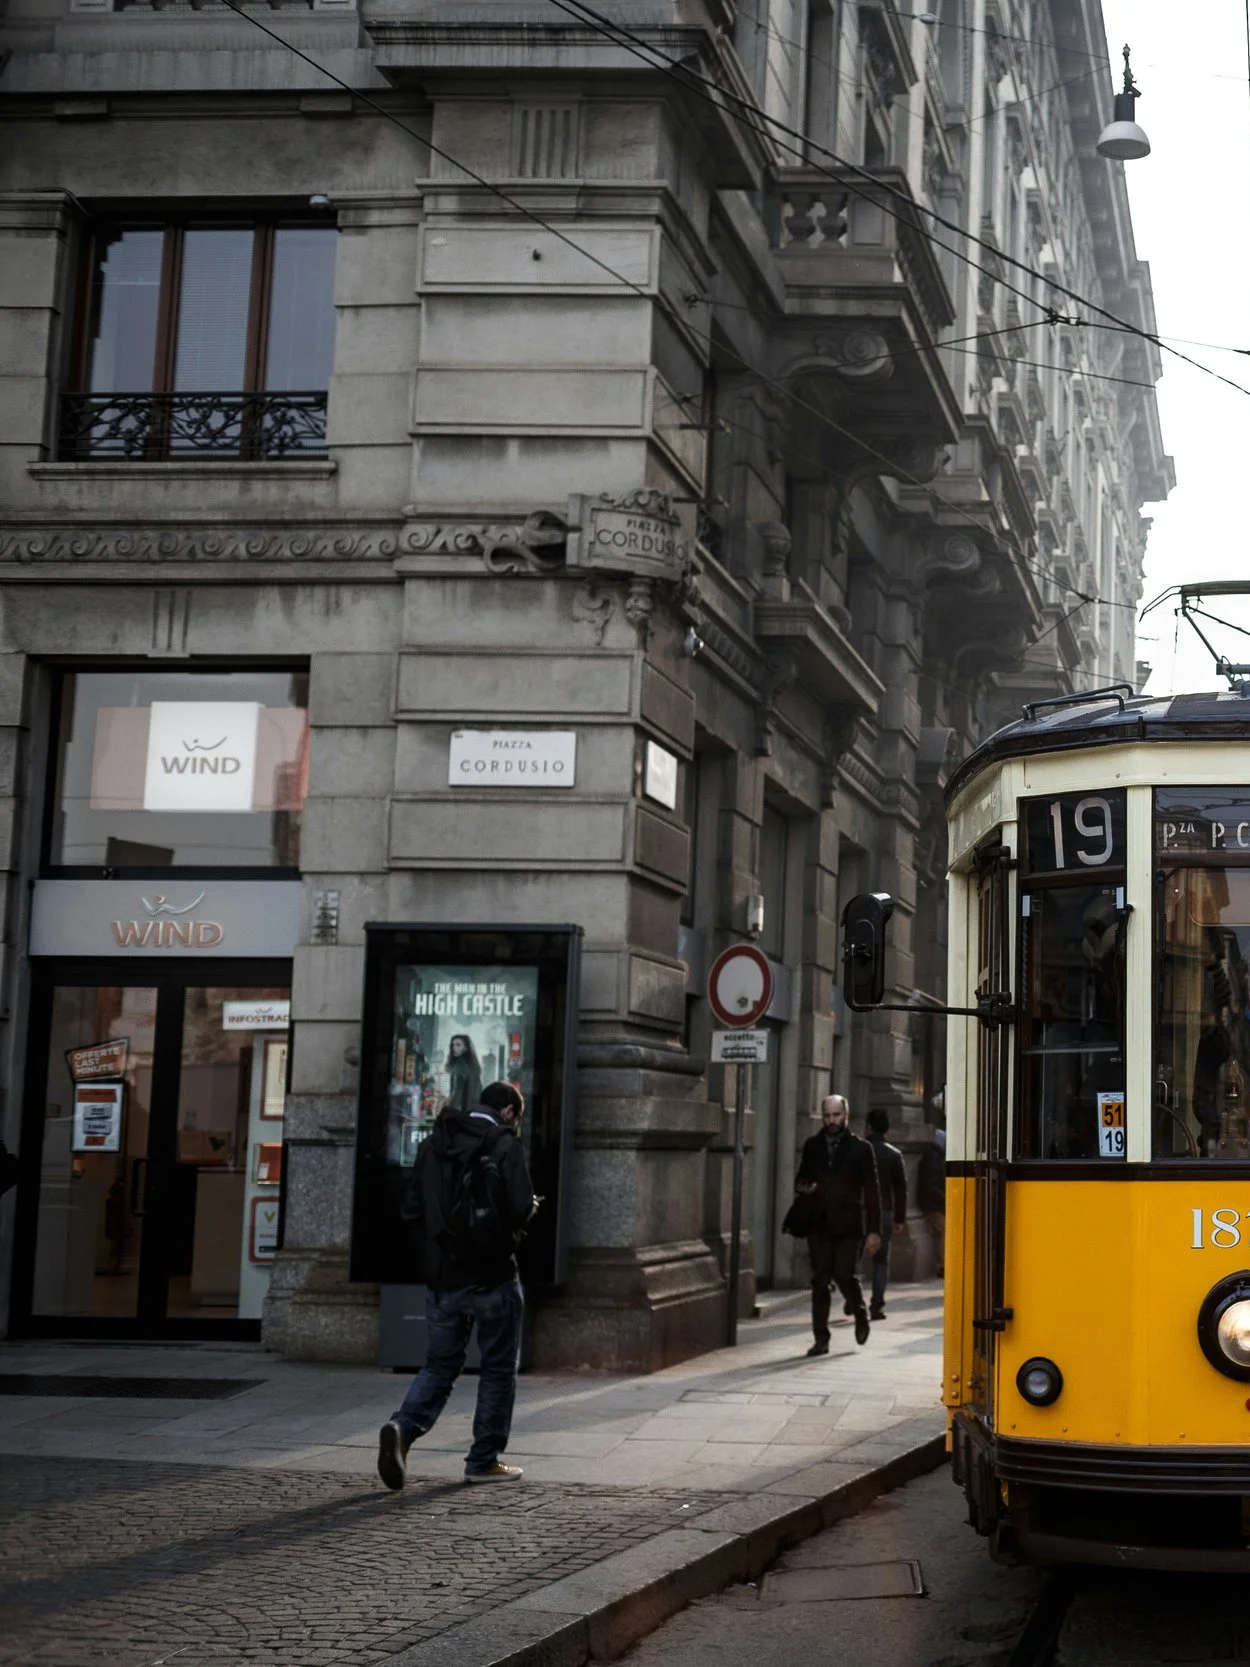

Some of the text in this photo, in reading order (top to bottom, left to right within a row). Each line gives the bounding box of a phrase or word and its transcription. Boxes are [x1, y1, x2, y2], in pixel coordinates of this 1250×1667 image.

[626, 518, 666, 535] PIAZZA
[597, 529, 686, 561] CORDUSIO
[492, 740, 532, 749] PIAZZA
[160, 756, 241, 775] WIND
[460, 759, 564, 773] CORDUSIO
[1050, 797, 1114, 869] 19
[1211, 822, 1227, 848] P.
[110, 919, 224, 948] WIND
[434, 982, 508, 995] THE MAN IN THE
[415, 993, 524, 1017] HIGH CASTLE
[73, 1047, 121, 1061] OFFERTE
[74, 1058, 100, 1069] LAST
[75, 1063, 114, 1075] MINUTE
[1103, 1103, 1123, 1127] 51
[1105, 1130, 1124, 1152] 19
